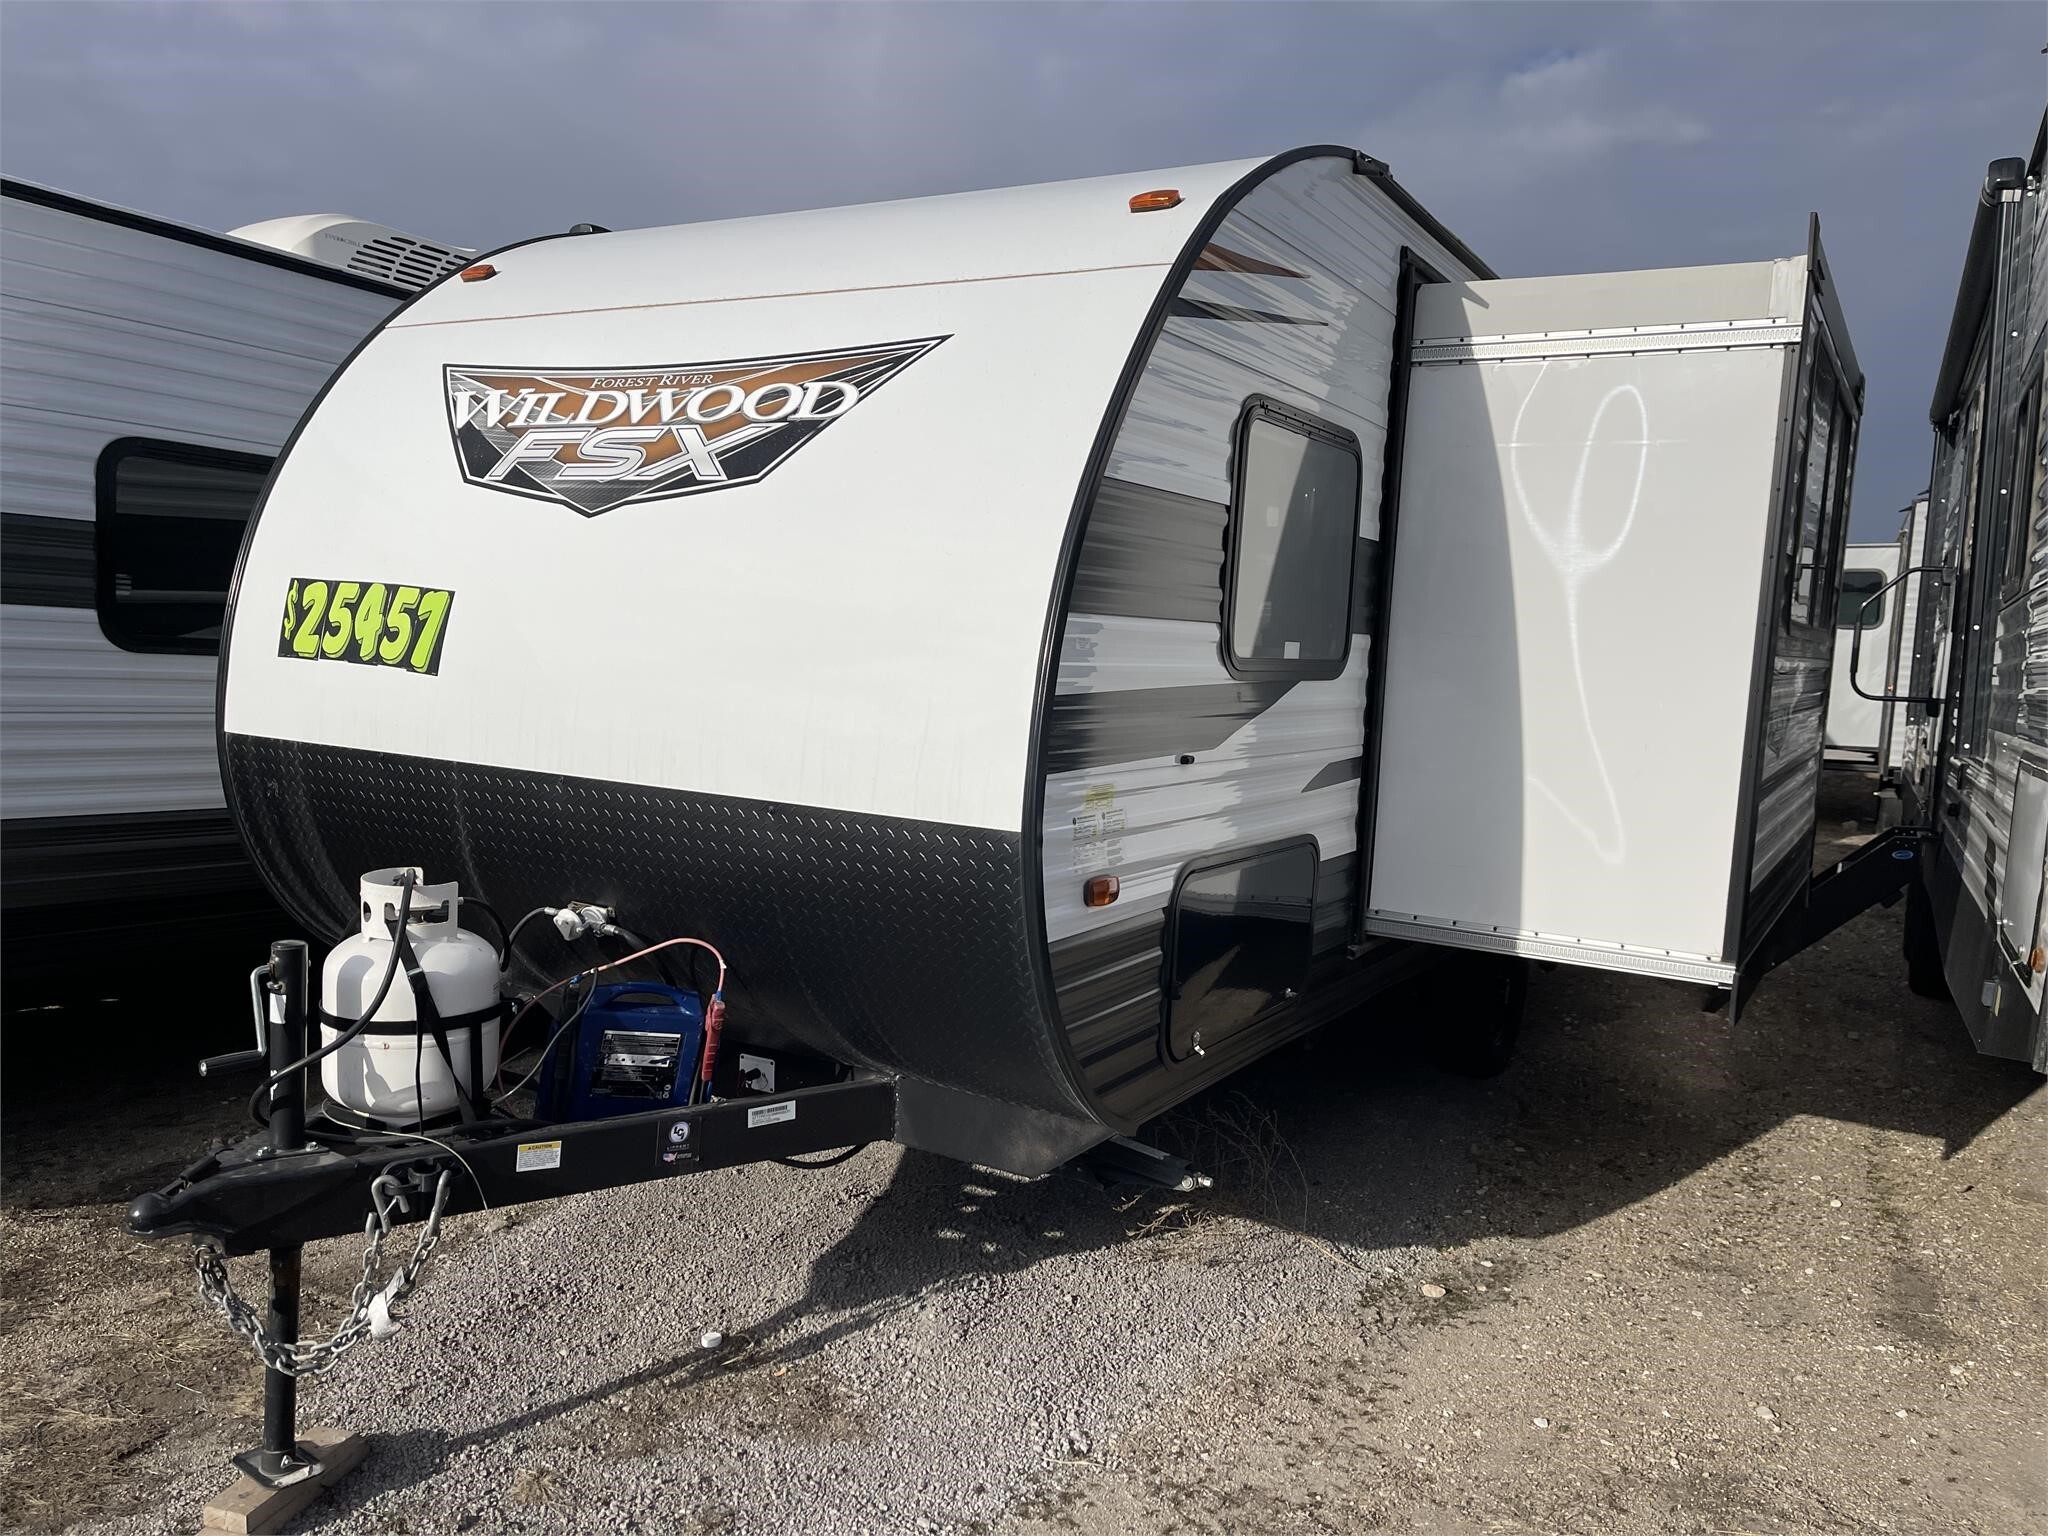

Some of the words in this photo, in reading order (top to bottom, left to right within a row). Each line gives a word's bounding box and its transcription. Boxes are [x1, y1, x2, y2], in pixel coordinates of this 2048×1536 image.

[451, 380, 860, 429] WILDWOOD
[590, 376, 657, 389] FOREST
[659, 374, 714, 386] RIVER
[484, 423, 789, 481] FSX
